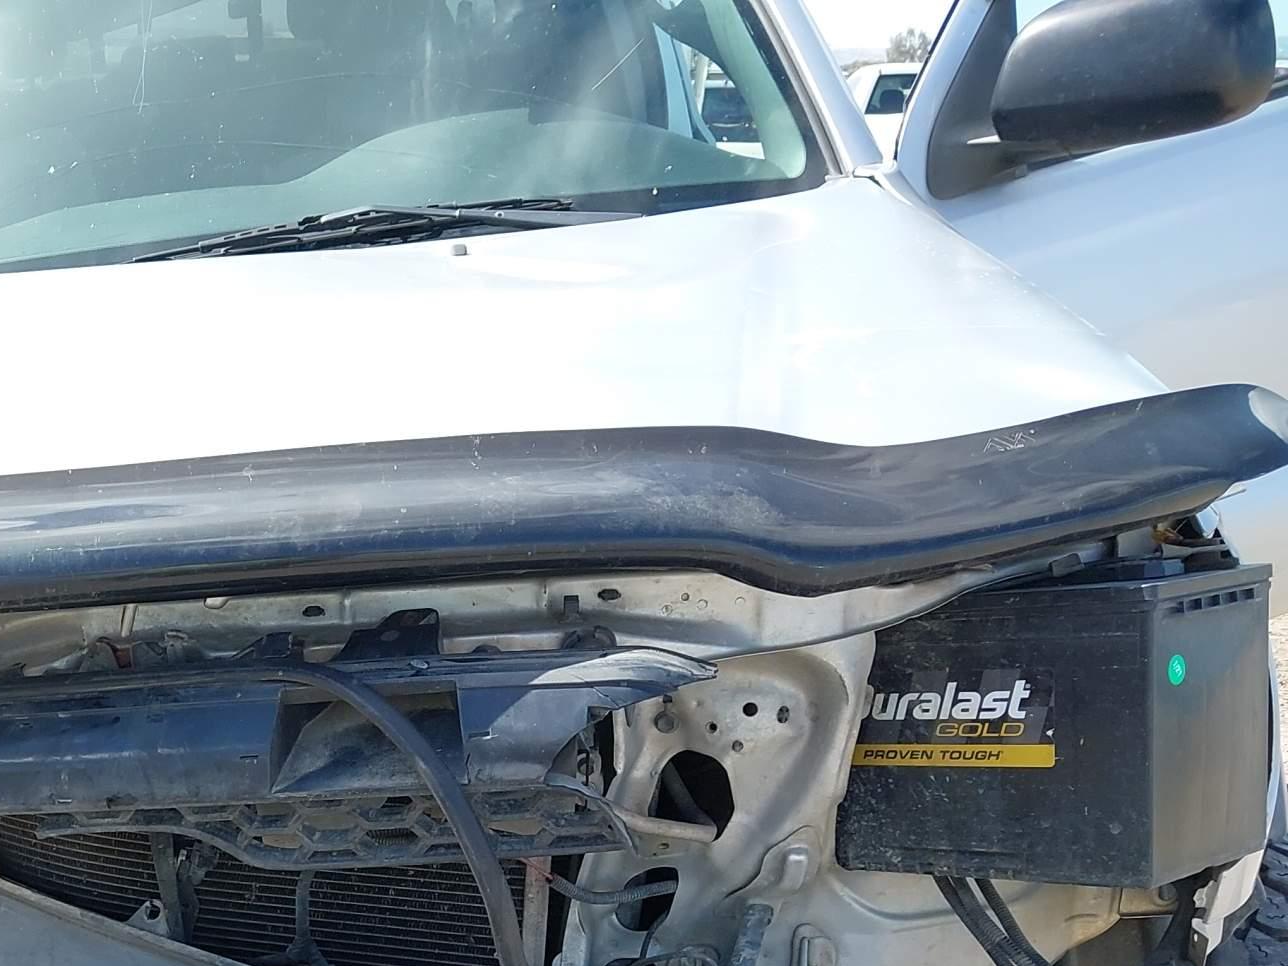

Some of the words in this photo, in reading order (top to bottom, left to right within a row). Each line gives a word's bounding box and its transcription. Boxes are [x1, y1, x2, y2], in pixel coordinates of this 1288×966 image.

[935, 722, 1025, 737] GOLD
[863, 750, 933, 760] PROVEN
[940, 750, 1001, 760] TOUGH
